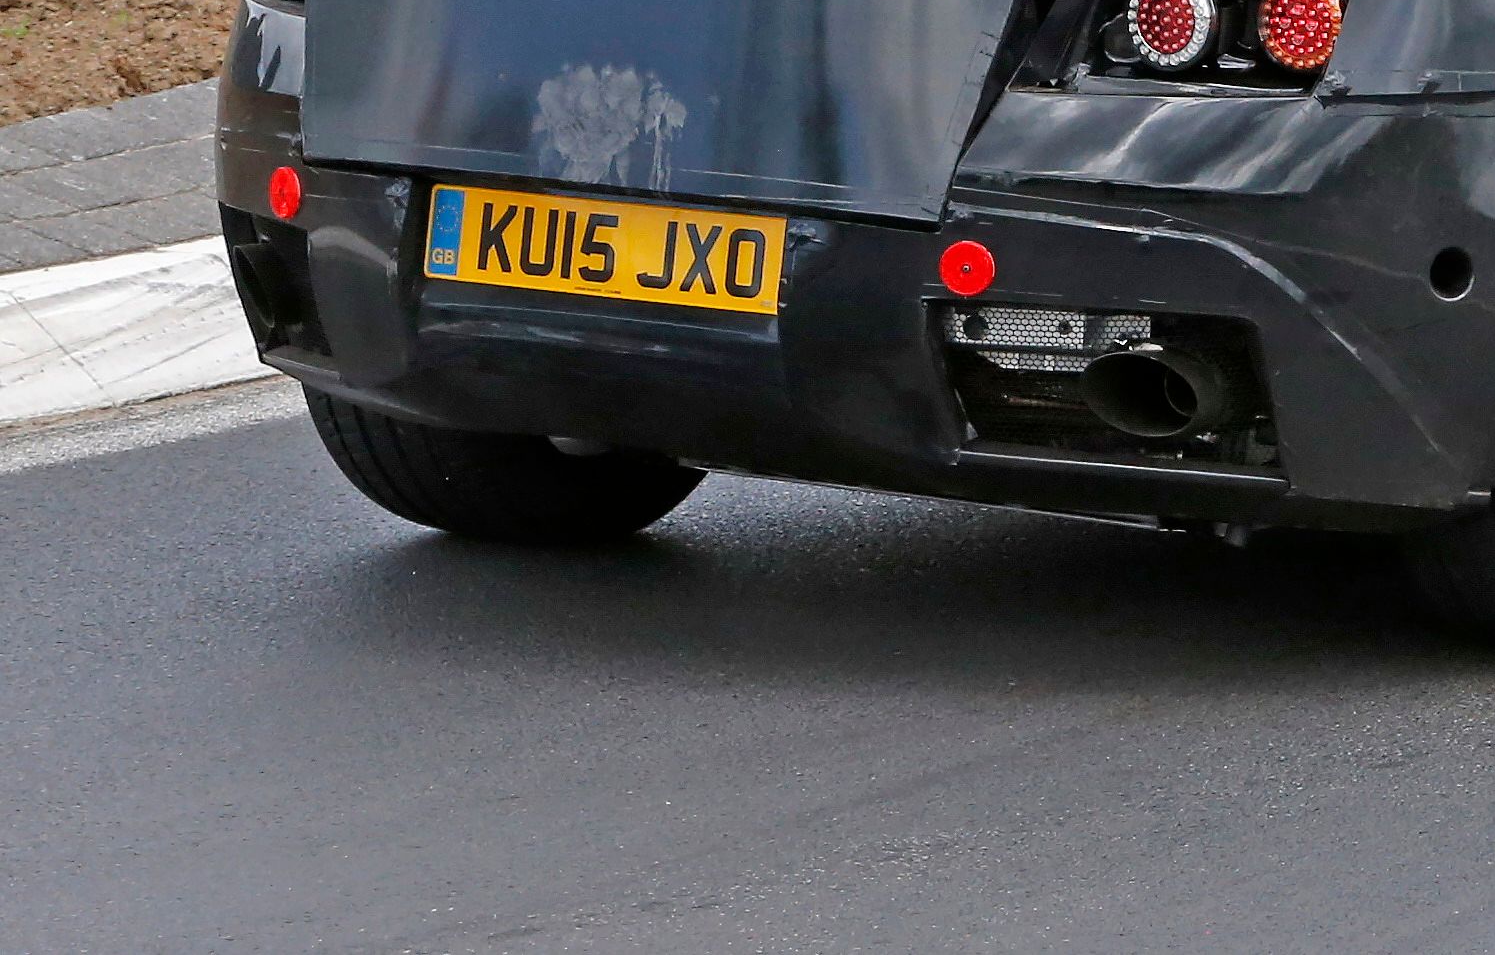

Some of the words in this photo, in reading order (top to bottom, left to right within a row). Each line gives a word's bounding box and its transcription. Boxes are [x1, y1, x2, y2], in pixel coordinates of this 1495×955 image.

[431, 247, 456, 266] GB
[477, 202, 619, 283] KU15
[636, 221, 765, 299] JXO
